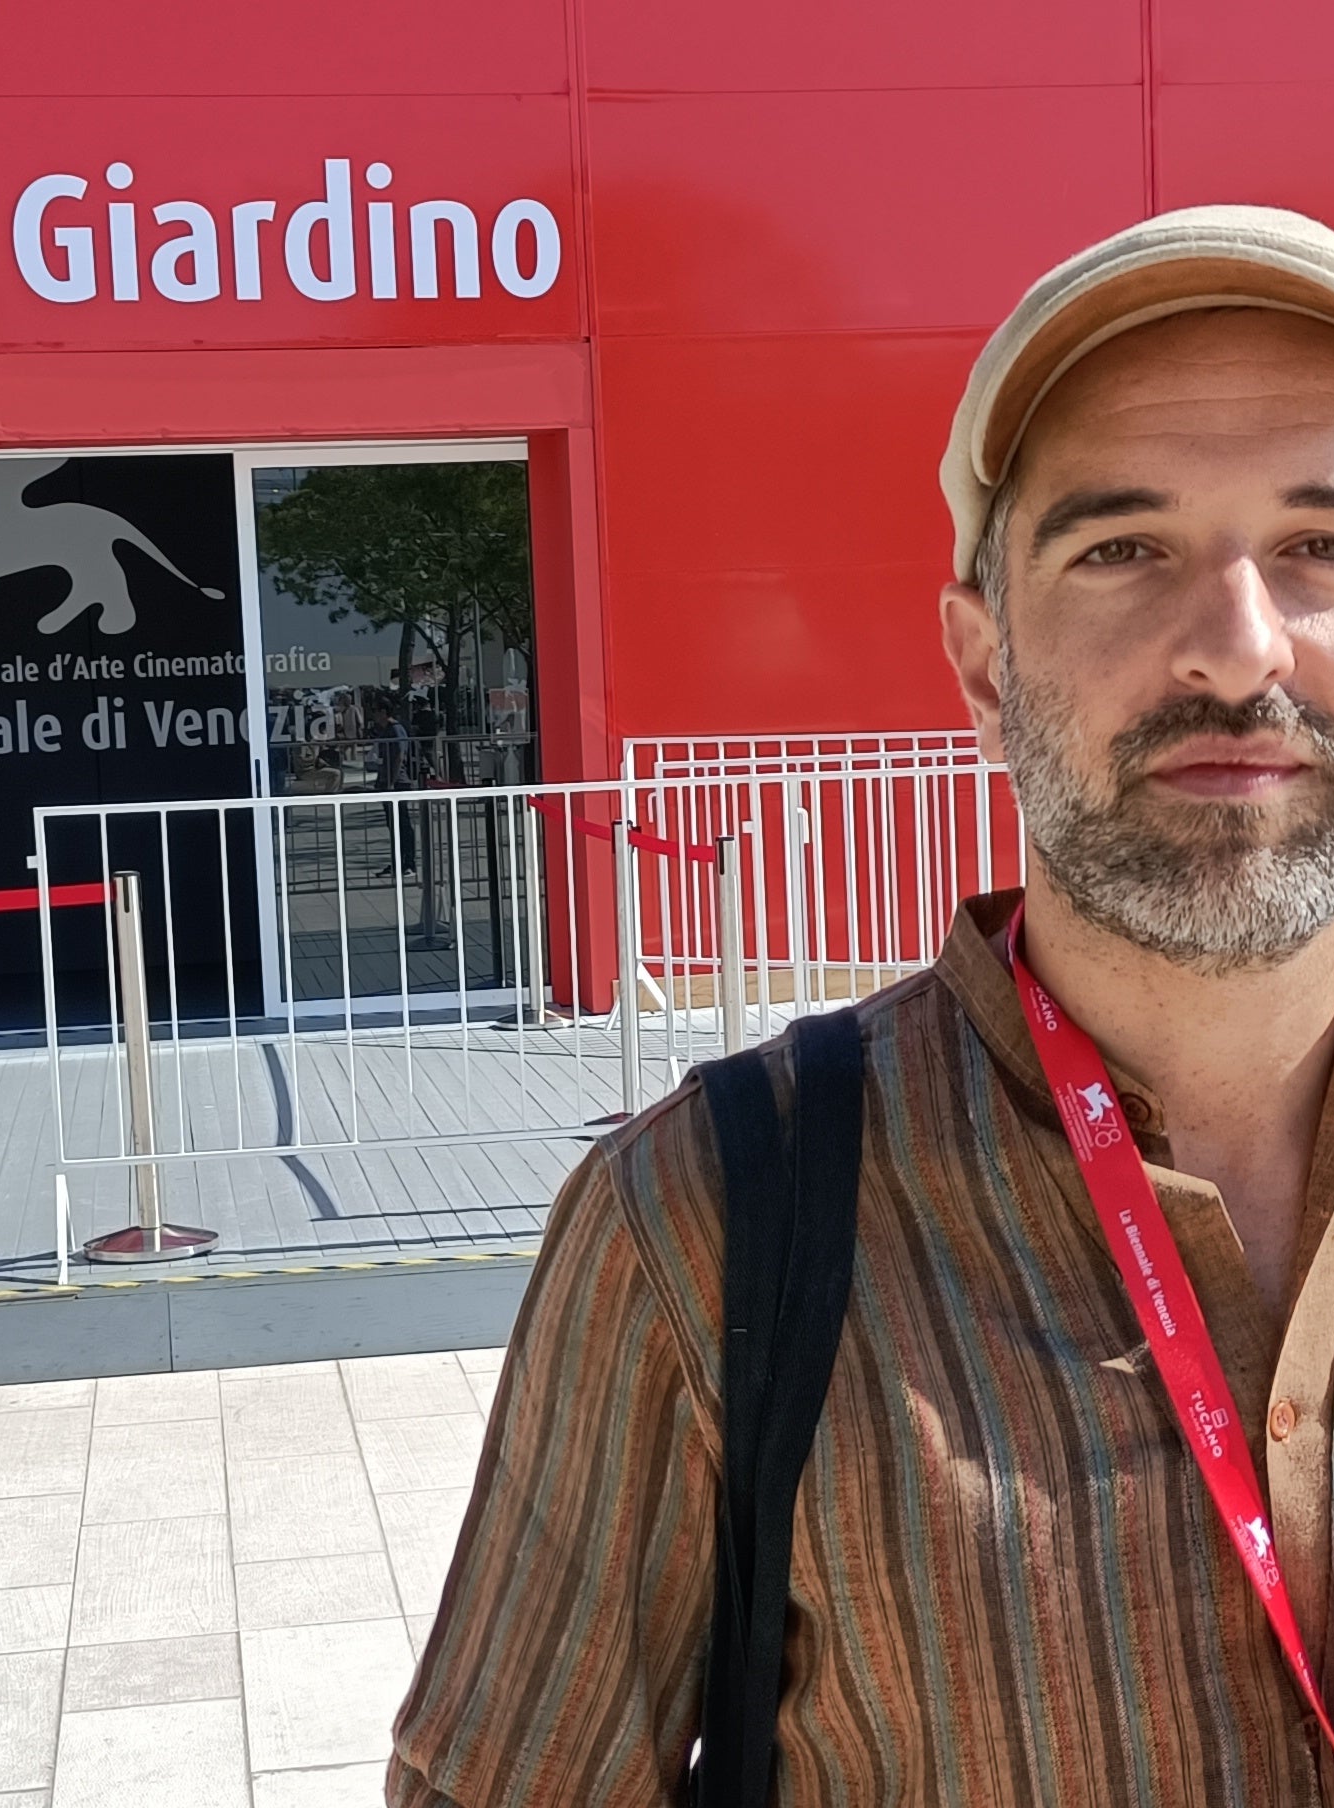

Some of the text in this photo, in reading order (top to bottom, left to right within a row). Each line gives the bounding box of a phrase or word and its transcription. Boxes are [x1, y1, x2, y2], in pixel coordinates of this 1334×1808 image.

[12, 158, 562, 304] Giardino
[133, 646, 332, 678] Cinematorafica
[81, 695, 127, 751] di
[1089, 1111, 1122, 1148] 78
[1119, 1209, 1176, 1337] La Biennale di Venezia
[1191, 1390, 1223, 1458] TUCANO
